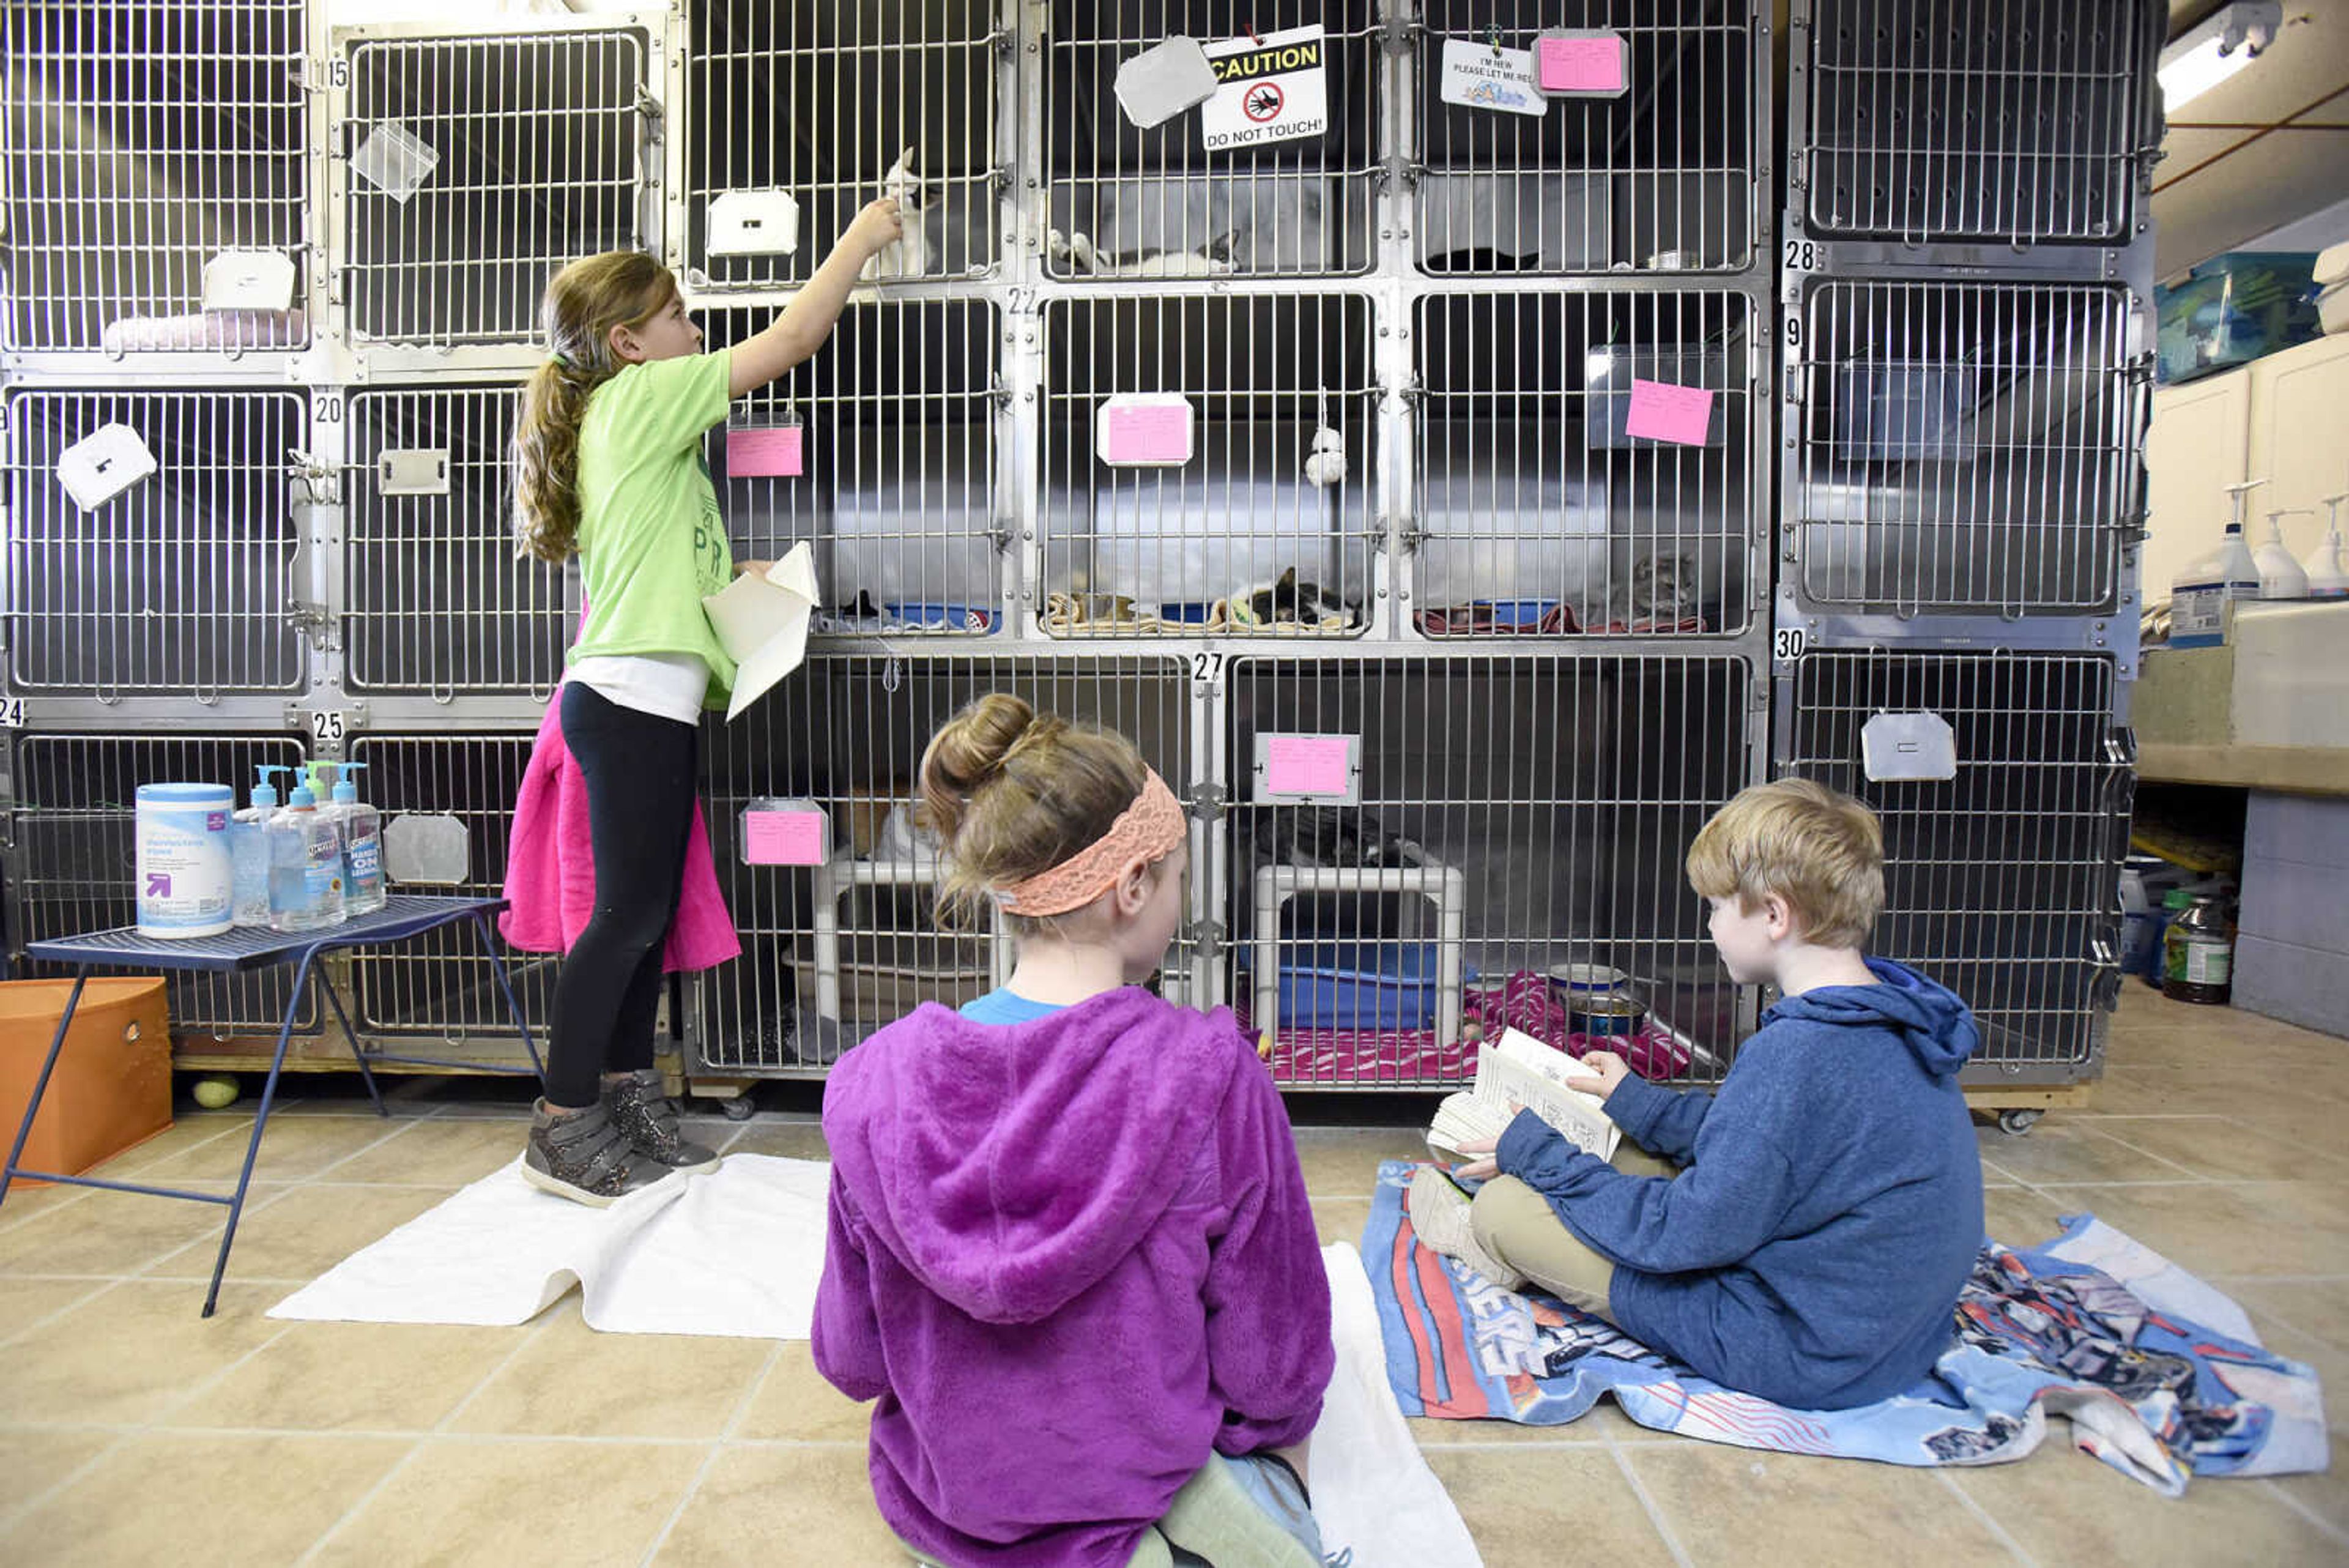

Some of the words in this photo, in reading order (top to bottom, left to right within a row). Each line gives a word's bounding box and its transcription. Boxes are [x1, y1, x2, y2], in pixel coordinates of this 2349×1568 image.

[330, 61, 347, 86] 15
[1211, 45, 1316, 80] CAUTION
[1453, 64, 1485, 76] PLEASE
[1486, 69, 1501, 78] LET
[1502, 71, 1514, 81] ME
[1493, 59, 1512, 69] NEW
[1208, 133, 1228, 147] DO
[1233, 128, 1263, 143] NOT
[1267, 119, 1323, 138] TOUCH!
[1786, 240, 1814, 270] 28
[1009, 288, 1036, 314] 22
[1787, 318, 1800, 346] 9
[316, 398, 341, 423] 20
[1777, 630, 1803, 658] 30
[1195, 653, 1222, 681] 27
[0, 699, 21, 724] 24
[314, 713, 342, 738] 25
